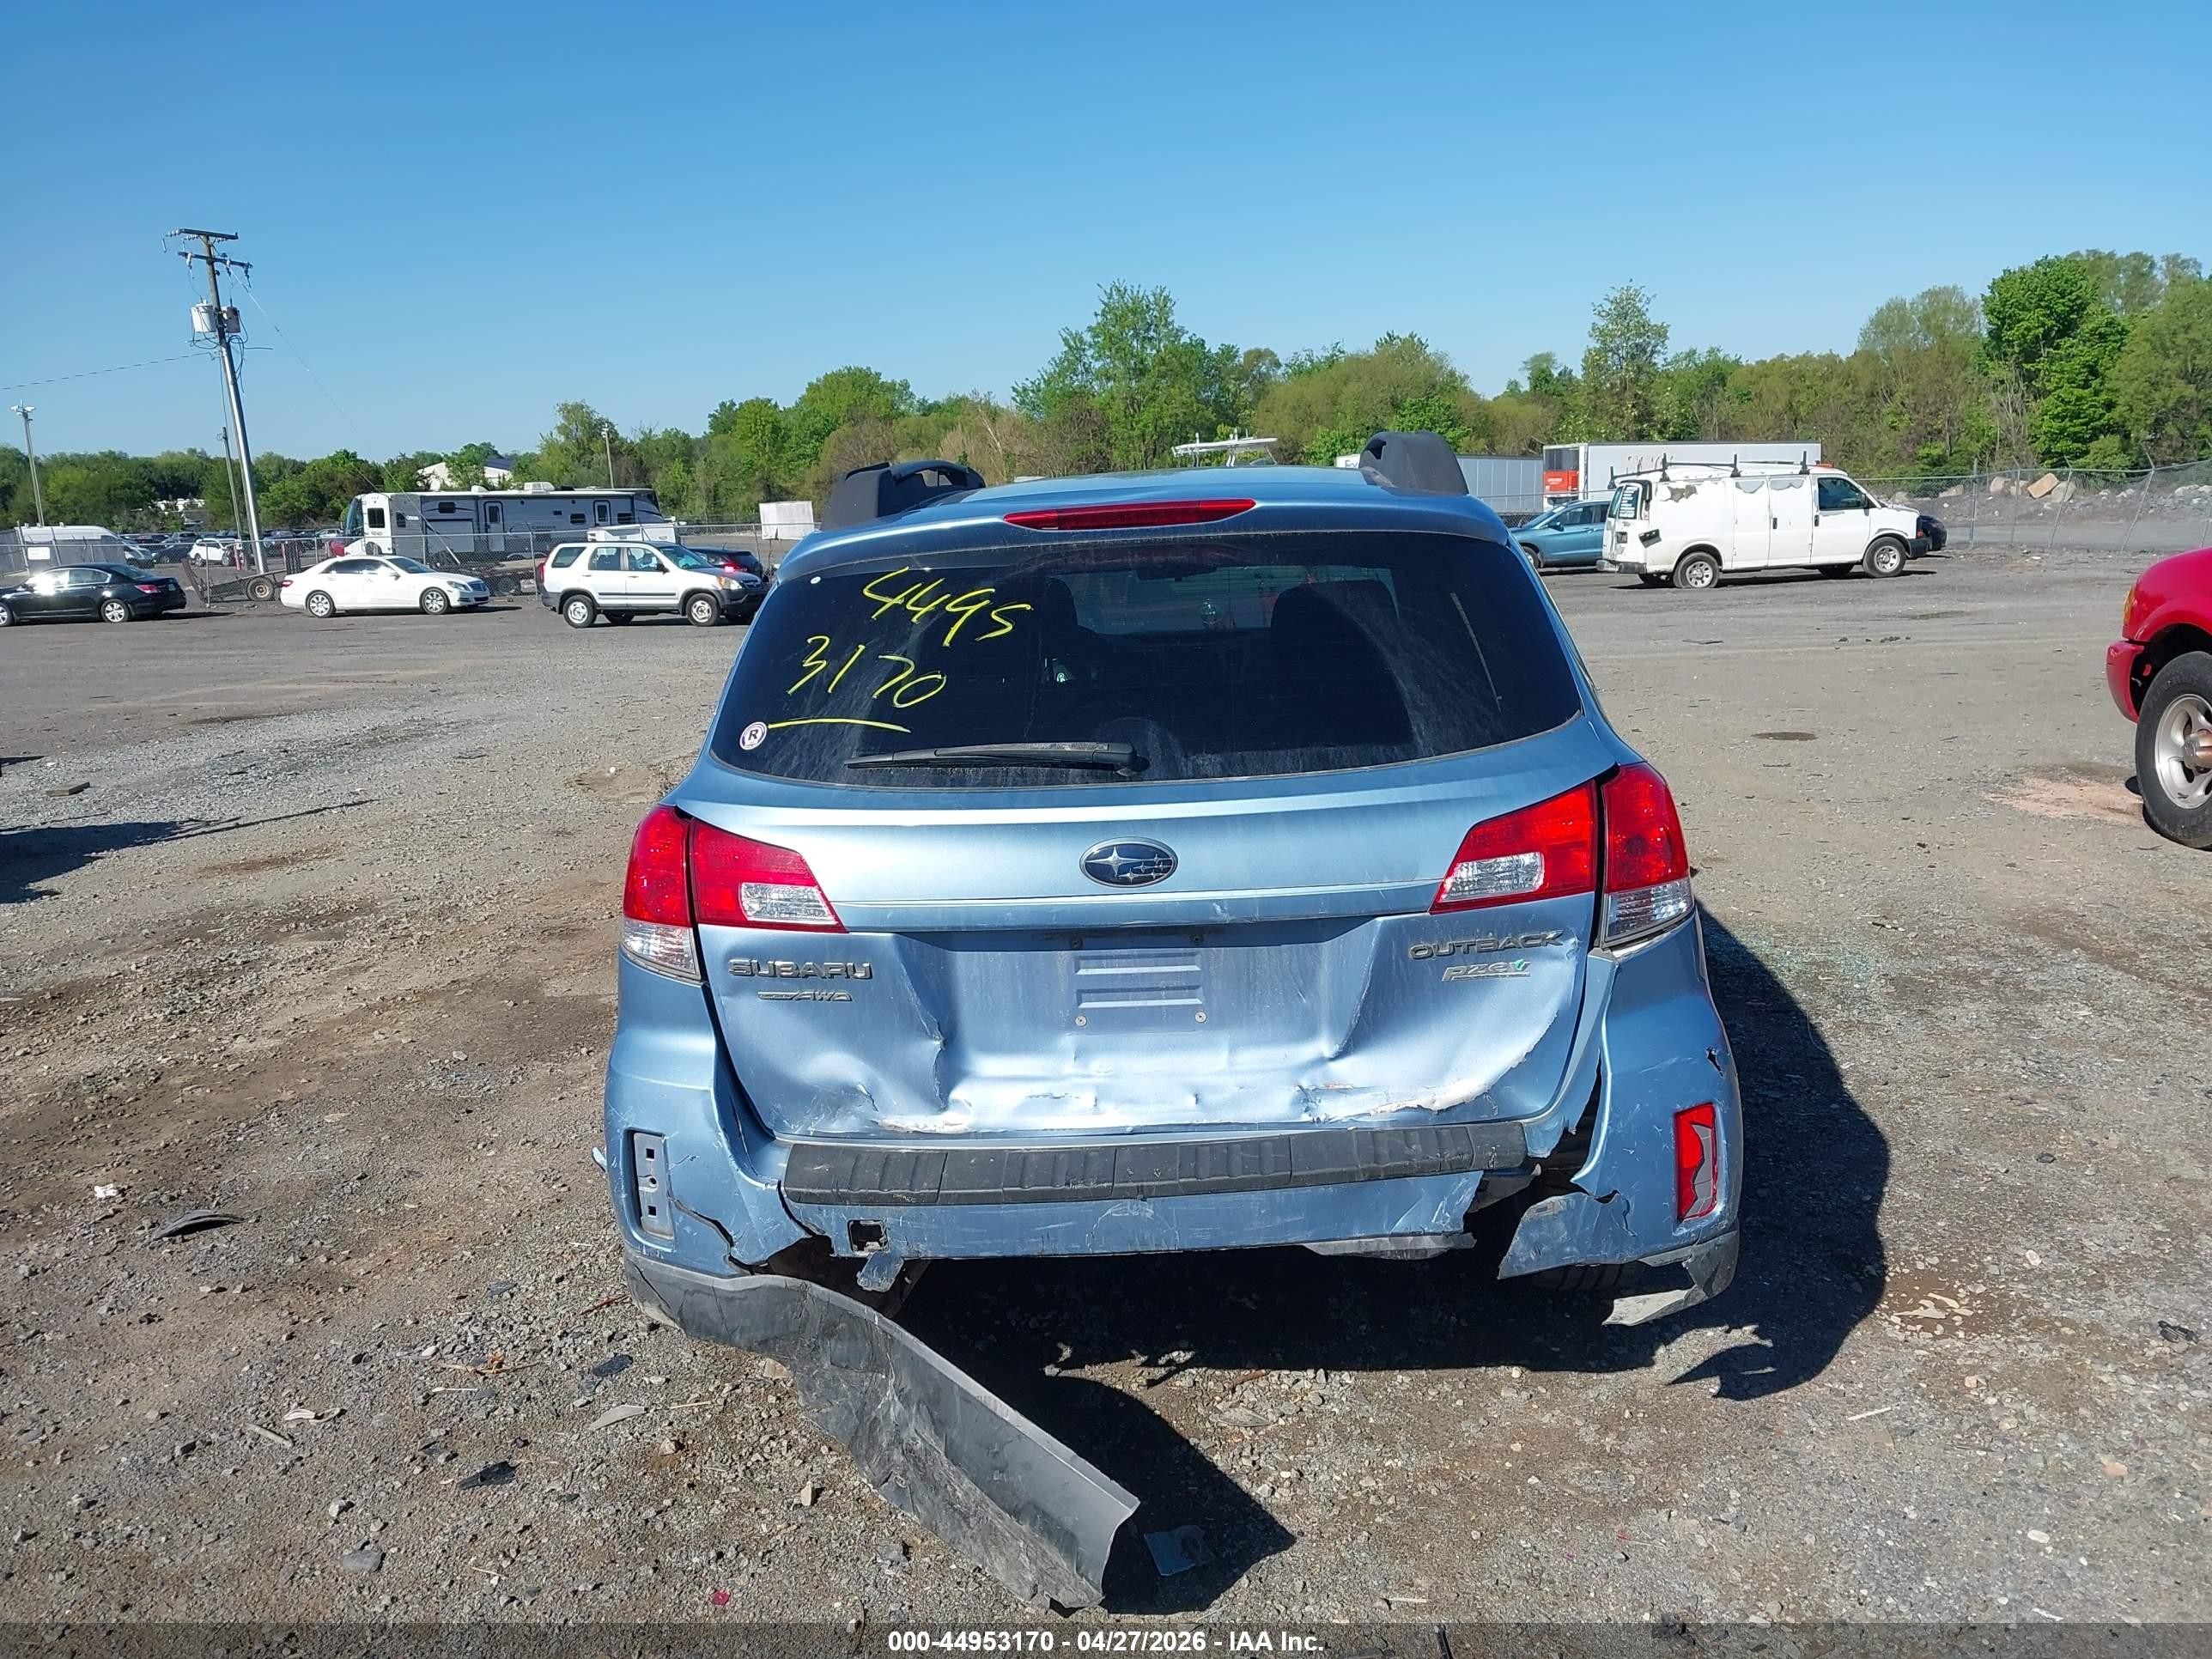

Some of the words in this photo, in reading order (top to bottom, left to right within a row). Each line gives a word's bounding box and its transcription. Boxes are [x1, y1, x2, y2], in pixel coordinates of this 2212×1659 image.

[862, 565, 1034, 647] 4495
[787, 634, 947, 708] 3170
[1409, 929, 1564, 960] OUTBACK
[728, 957, 873, 980] SUBARU
[793, 991, 853, 1002] AWD
